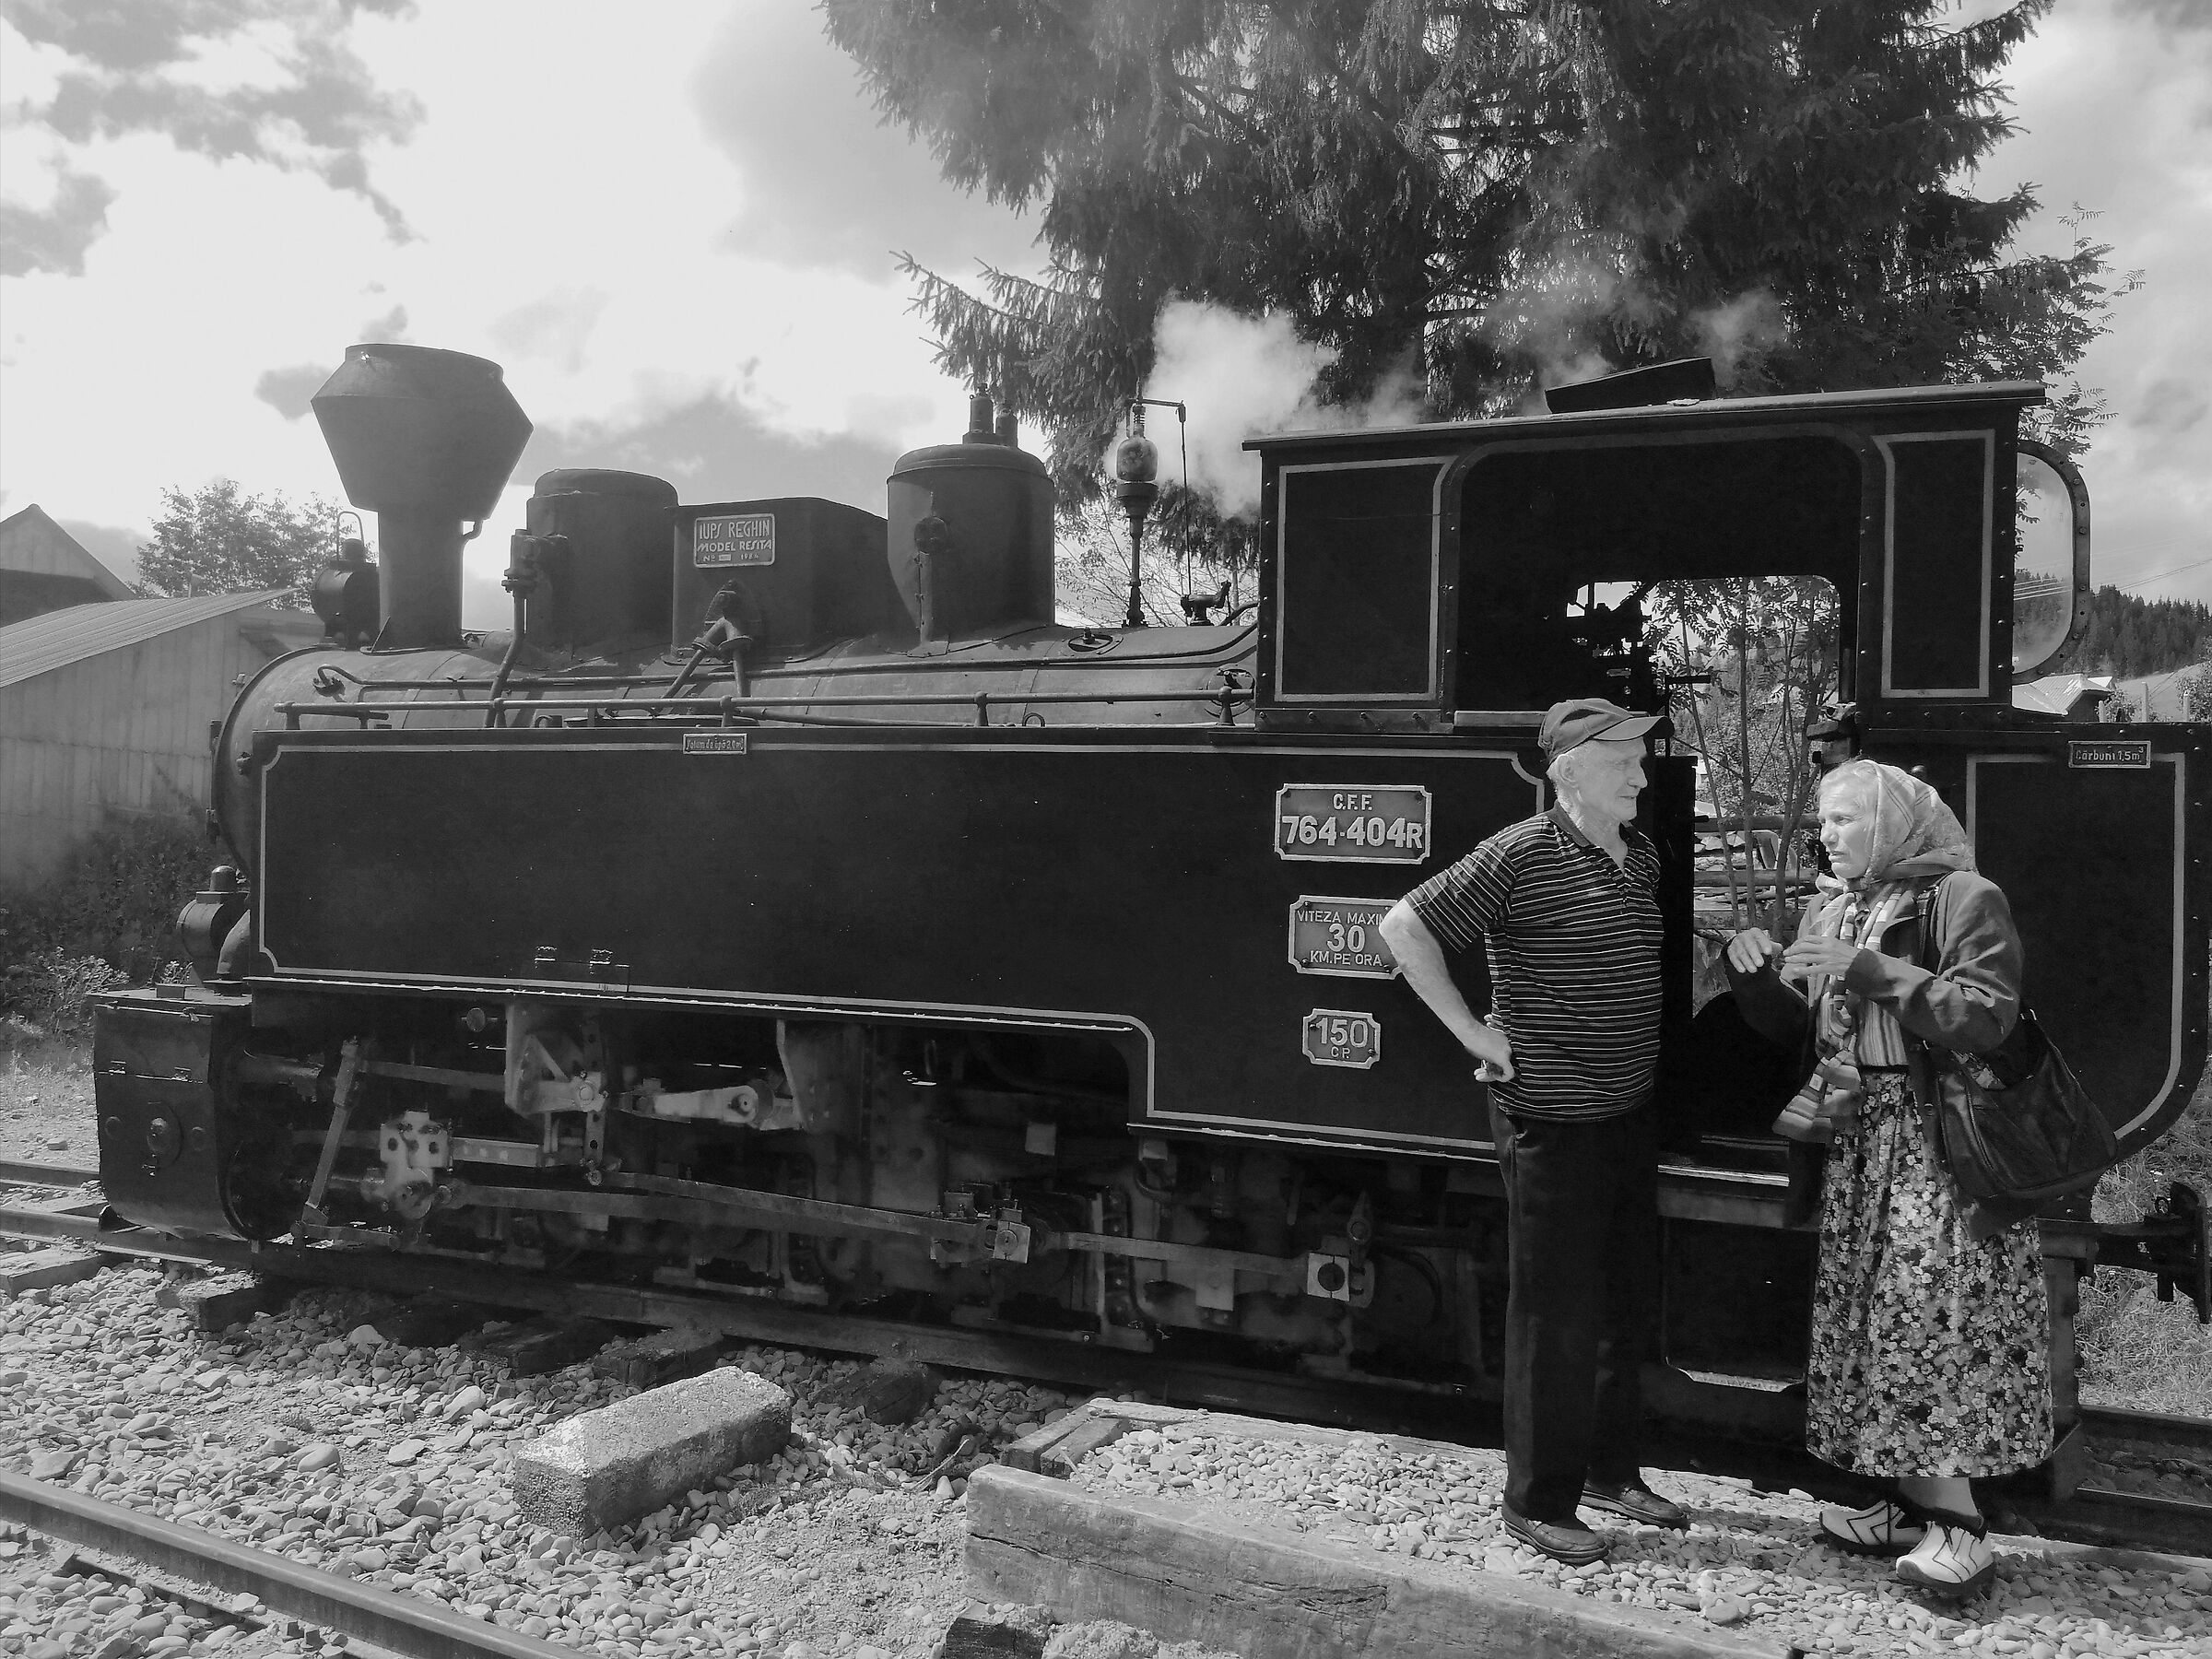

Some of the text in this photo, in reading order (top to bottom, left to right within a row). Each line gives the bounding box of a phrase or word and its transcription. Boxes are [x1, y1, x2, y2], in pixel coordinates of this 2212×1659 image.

[700, 520, 770, 540] IUPS REGHIN
[697, 542, 735, 552] MODEL
[1333, 794, 1373, 811] C.F.F.
[1297, 910, 1341, 924] VITEZA
[1326, 923, 1366, 953] 30
[1355, 954, 1382, 967] ORA
[1315, 1017, 1369, 1048] 150
